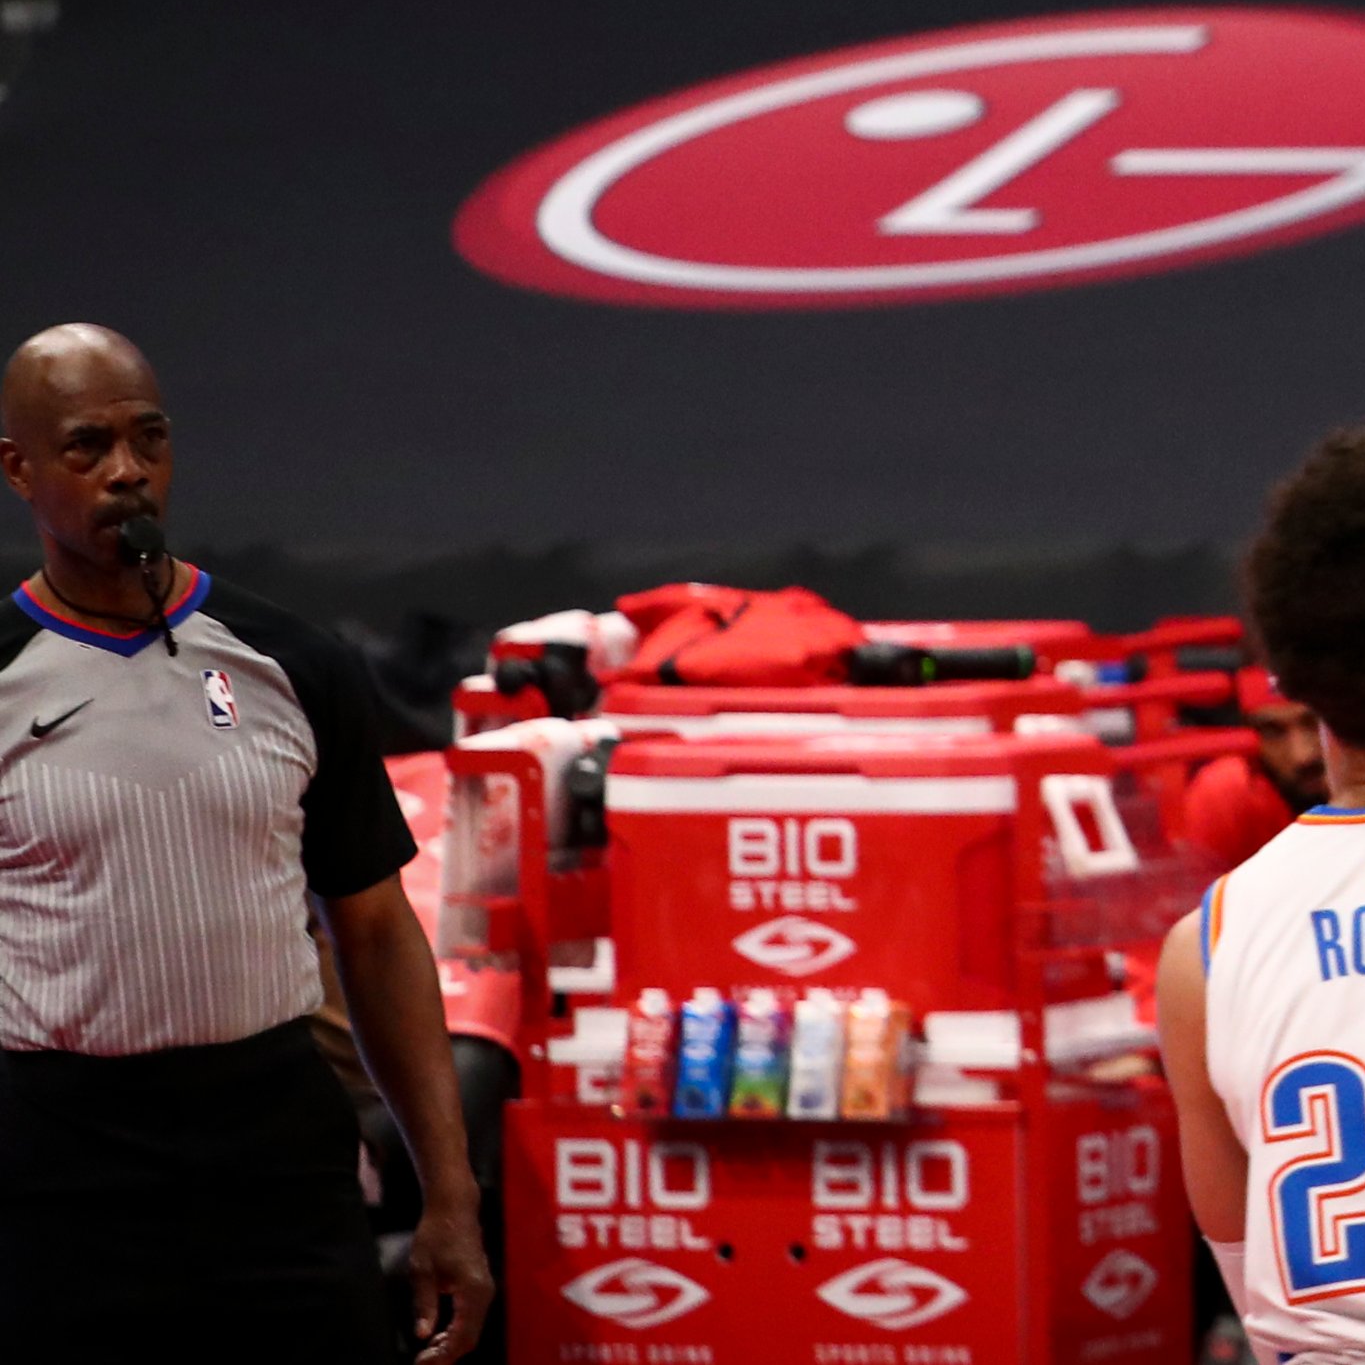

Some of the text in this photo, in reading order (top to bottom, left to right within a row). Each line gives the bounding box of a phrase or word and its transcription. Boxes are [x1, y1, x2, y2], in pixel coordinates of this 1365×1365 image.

[728, 818, 858, 878] BIO
[729, 880, 859, 913] STEEL
[555, 1138, 711, 1209] BIO
[811, 1139, 970, 1210] BIO
[1076, 1126, 1160, 1204] BIO
[556, 1214, 711, 1250] STEEL
[811, 1214, 970, 1251] STEEL
